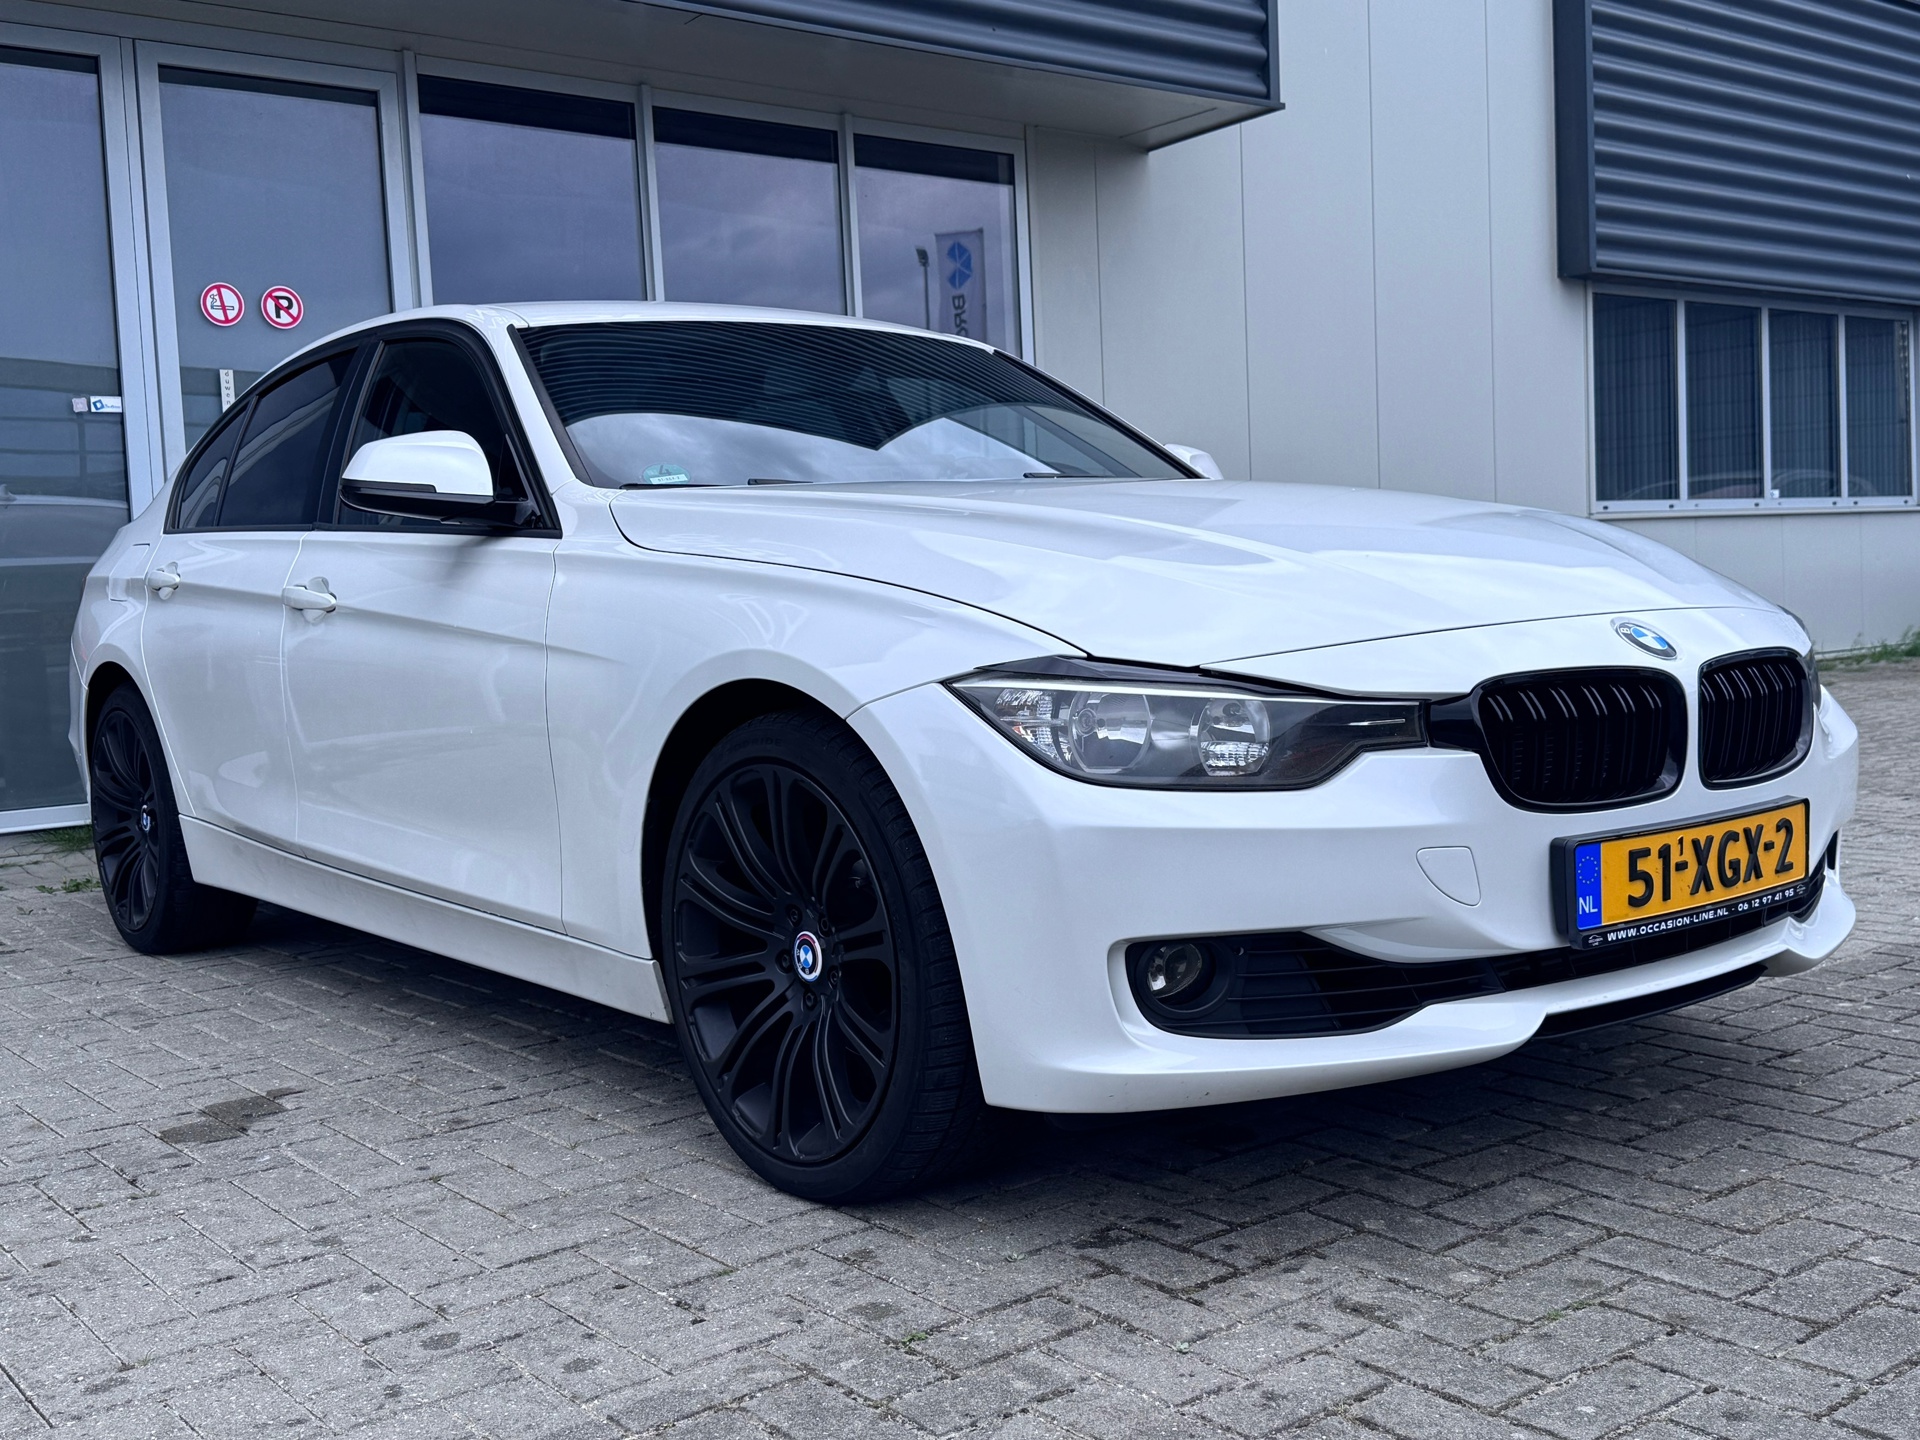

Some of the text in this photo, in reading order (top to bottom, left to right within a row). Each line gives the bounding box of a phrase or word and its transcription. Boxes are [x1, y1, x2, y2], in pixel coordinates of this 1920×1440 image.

[1627, 817, 1794, 907] 51-XGX-2
[1578, 895, 1598, 915] NL
[1607, 907, 1729, 942] WWW.OCCASION-LINE.NL
[1738, 903, 1748, 912] 06
[1752, 899, 1760, 908] 12
[1762, 896, 1772, 905] 97
[1774, 892, 1782, 901] 41
[1784, 888, 1794, 898] 95
